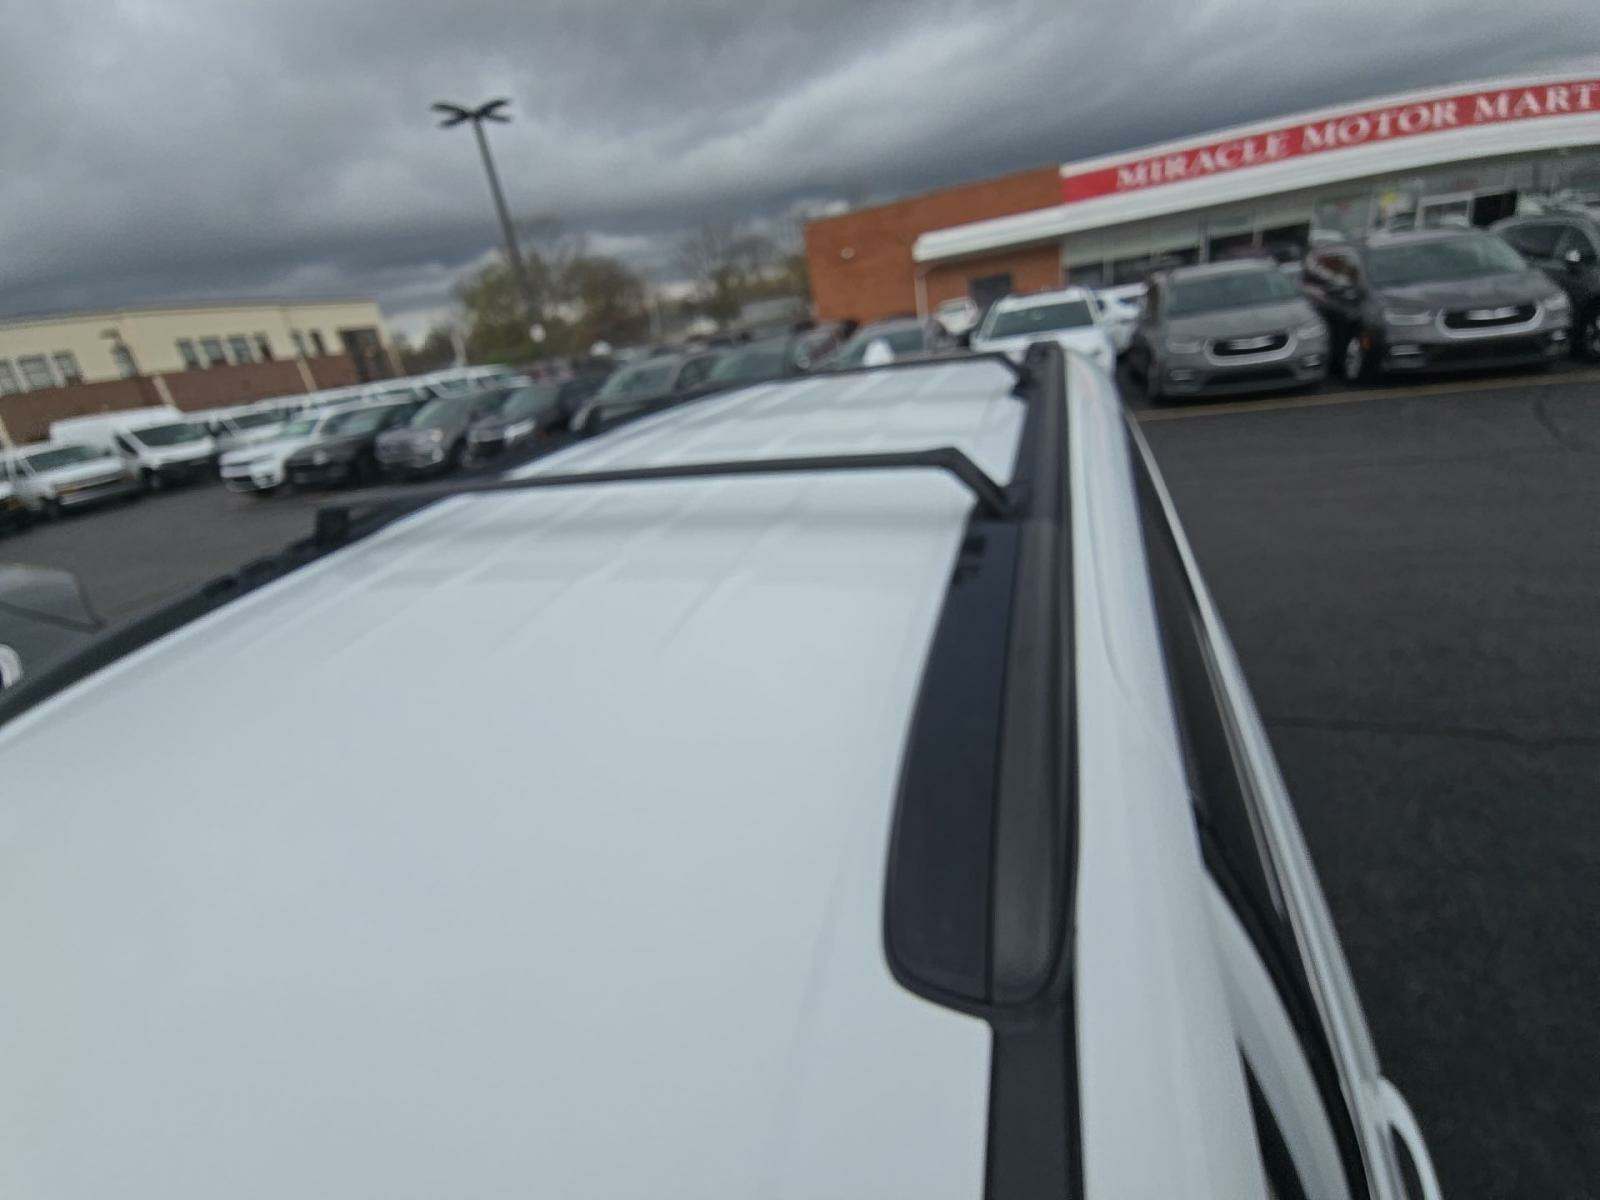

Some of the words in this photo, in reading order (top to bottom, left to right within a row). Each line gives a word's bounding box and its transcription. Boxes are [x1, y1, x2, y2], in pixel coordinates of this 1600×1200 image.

[1117, 132, 1290, 190] MIRACLE
[1302, 101, 1458, 151] MOTOR
[1473, 83, 1600, 121] MART
